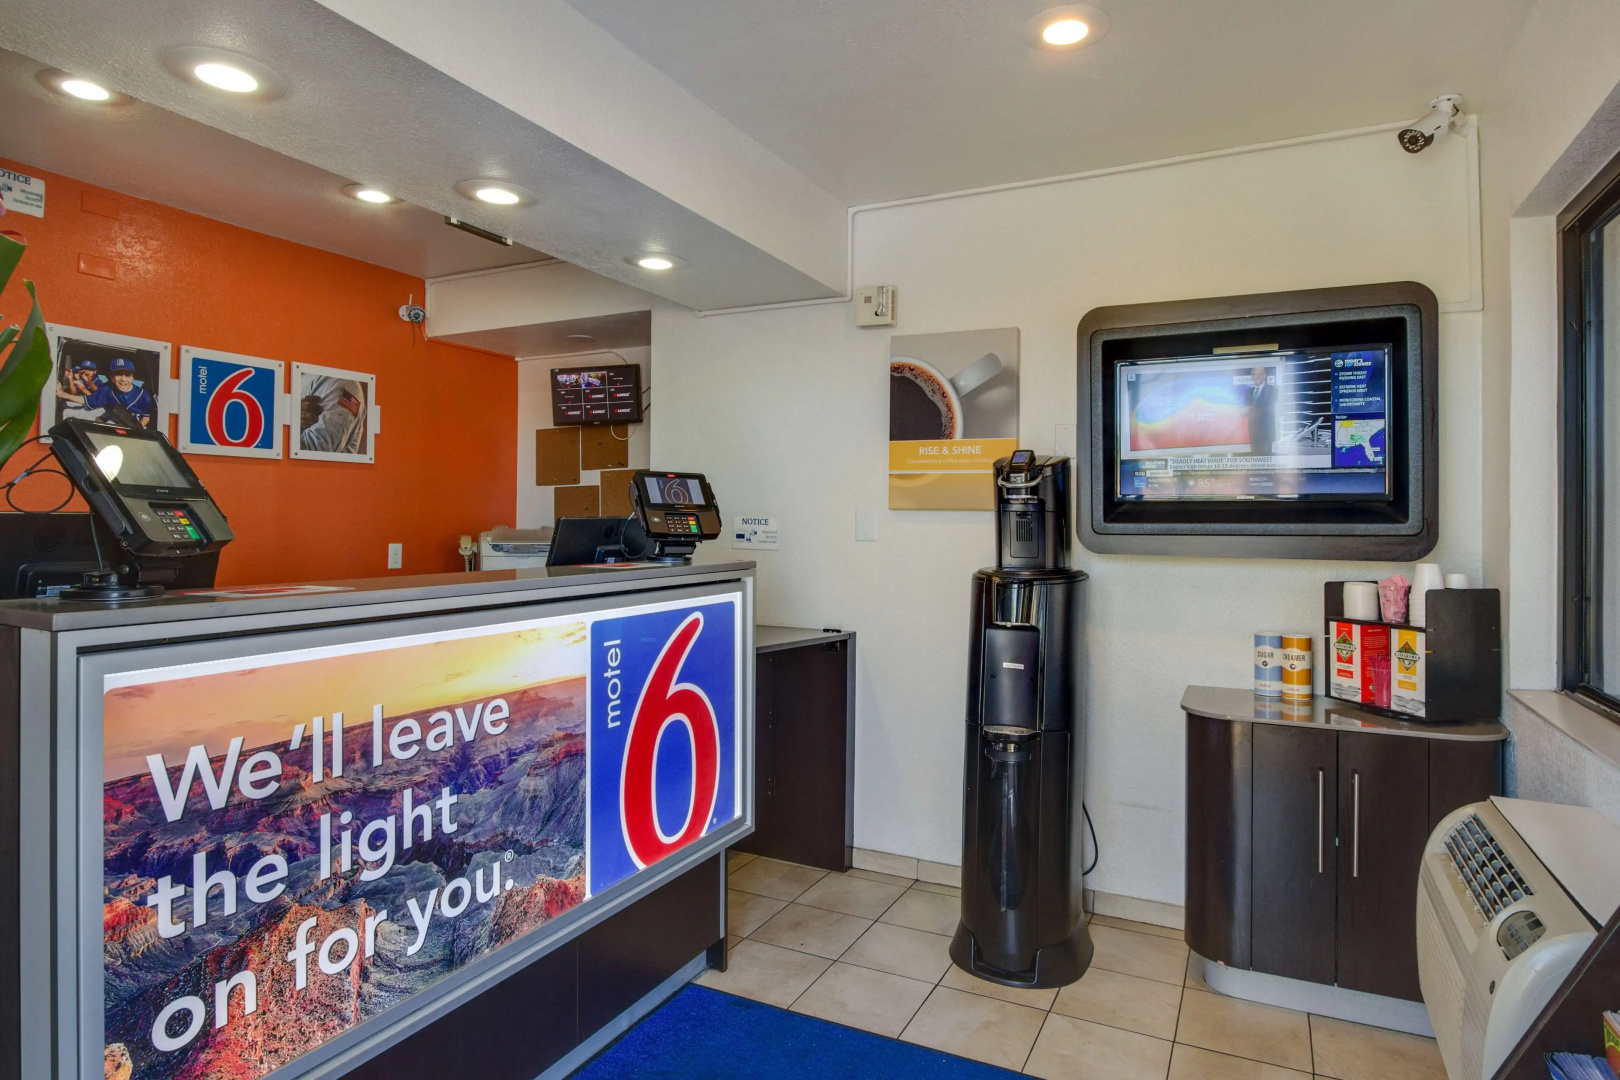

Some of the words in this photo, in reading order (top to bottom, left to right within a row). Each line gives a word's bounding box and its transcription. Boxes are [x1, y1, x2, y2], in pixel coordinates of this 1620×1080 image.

[198, 366, 207, 394] motel
[205, 367, 264, 448] 6
[919, 446, 939, 455] RISE
[942, 446, 949, 455] &
[952, 445, 982, 454] SHINE
[604, 639, 621, 728] motel
[1283, 653, 1305, 661] CREAMER
[146, 711, 344, 823] We'll
[373, 698, 510, 767] leave
[619, 611, 720, 870] 6
[147, 851, 289, 939] the
[320, 786, 458, 882] light
[152, 970, 257, 1052] on
[288, 909, 387, 991] for
